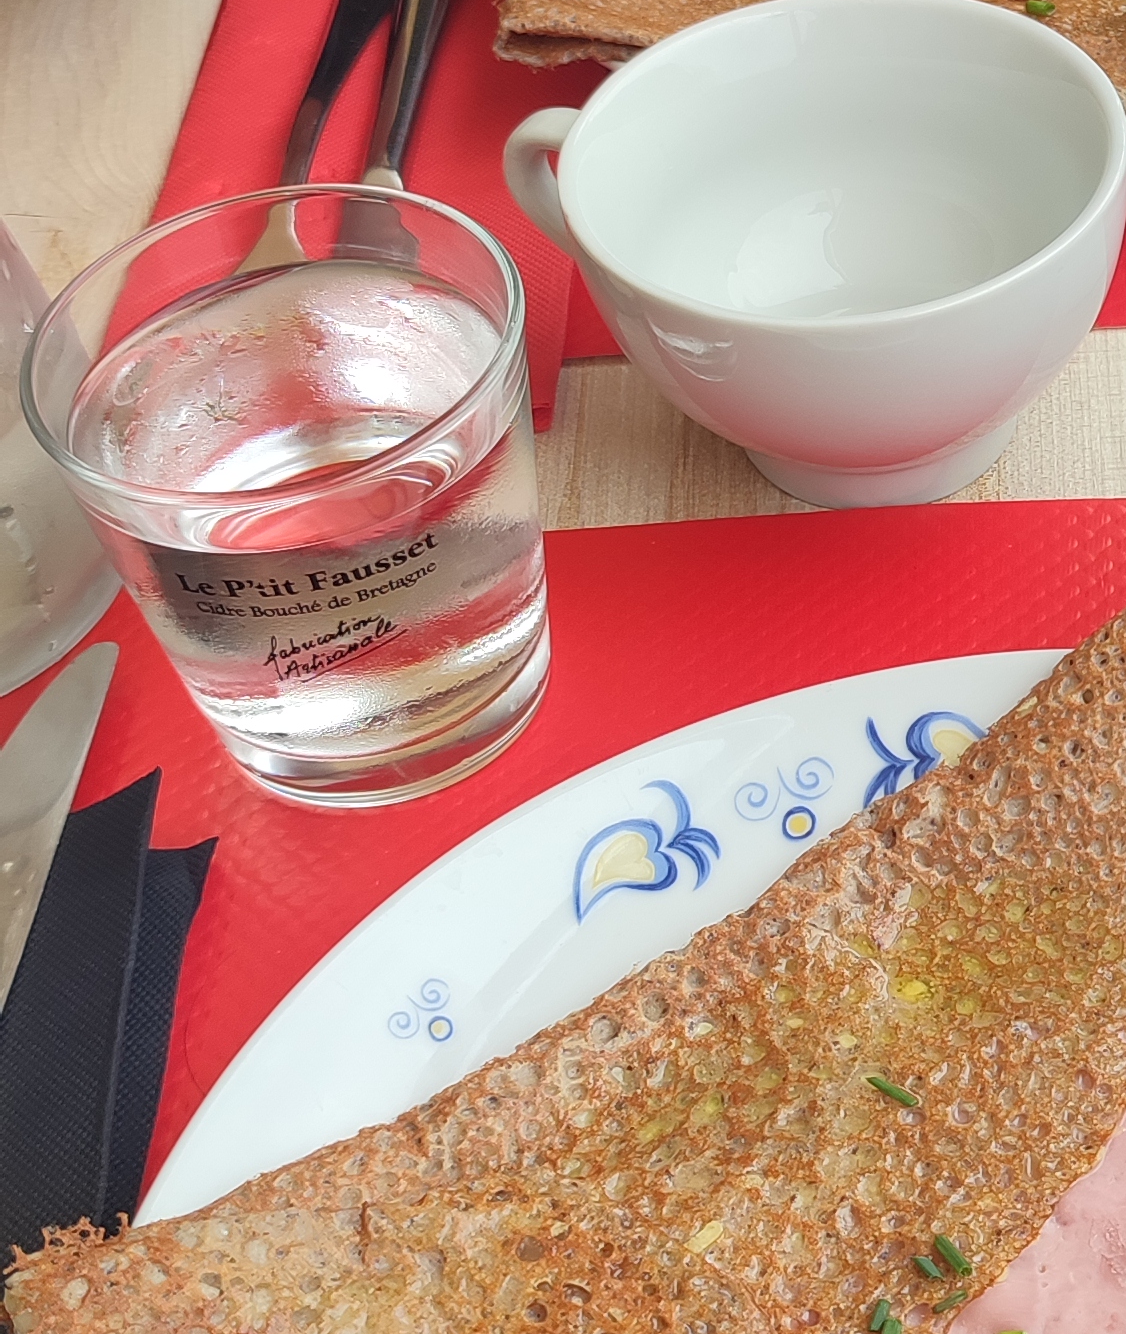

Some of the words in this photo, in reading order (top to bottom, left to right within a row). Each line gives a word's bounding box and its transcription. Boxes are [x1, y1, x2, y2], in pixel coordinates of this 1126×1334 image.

[175, 571, 216, 597] Le
[222, 578, 300, 599] P'tit
[304, 531, 439, 593] Fausset
[195, 600, 248, 618] Cidre
[249, 599, 323, 618] Bouché
[327, 594, 351, 610] de
[356, 561, 437, 603] Bretagne
